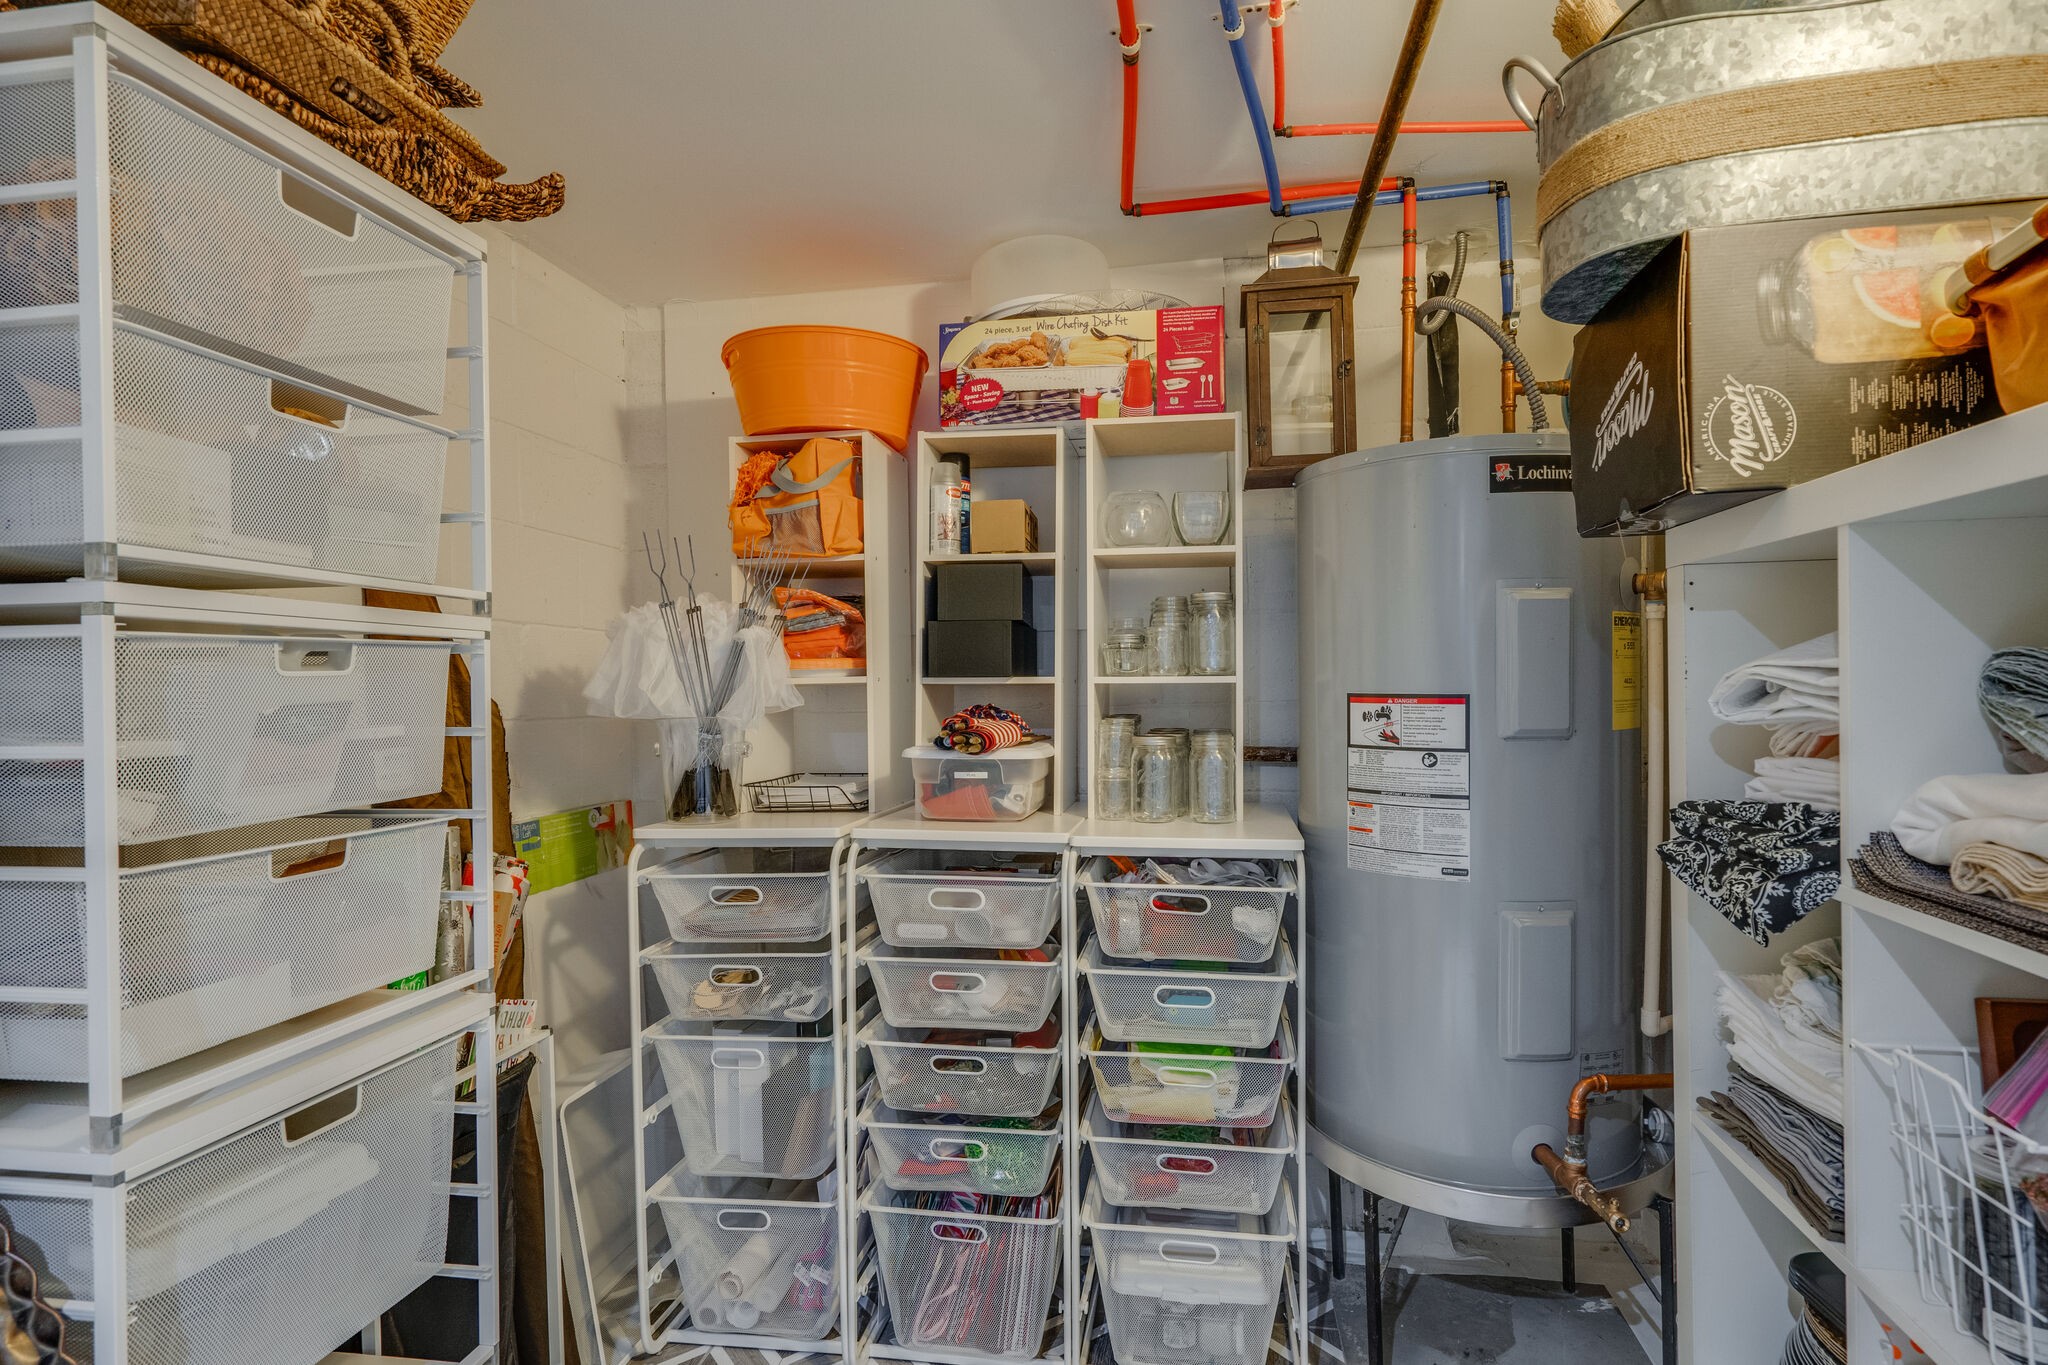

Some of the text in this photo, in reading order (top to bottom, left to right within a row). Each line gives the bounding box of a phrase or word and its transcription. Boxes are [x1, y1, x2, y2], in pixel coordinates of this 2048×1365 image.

[995, 327, 1014, 336] piece,
[1022, 325, 1032, 333] set
[1036, 320, 1055, 331] Wire
[1056, 316, 1090, 334] Chafing
[1093, 314, 1113, 328] Dish
[1114, 313, 1129, 326] Kit
[963, 393, 979, 402] Space
[983, 390, 1001, 399] Saving
[971, 383, 989, 393] NEW
[1591, 369, 1655, 473] Mason
[1701, 396, 1722, 461] AMERICANA
[1721, 373, 1765, 478] Mason
[1763, 389, 1794, 447] VINTAGE STYLE
